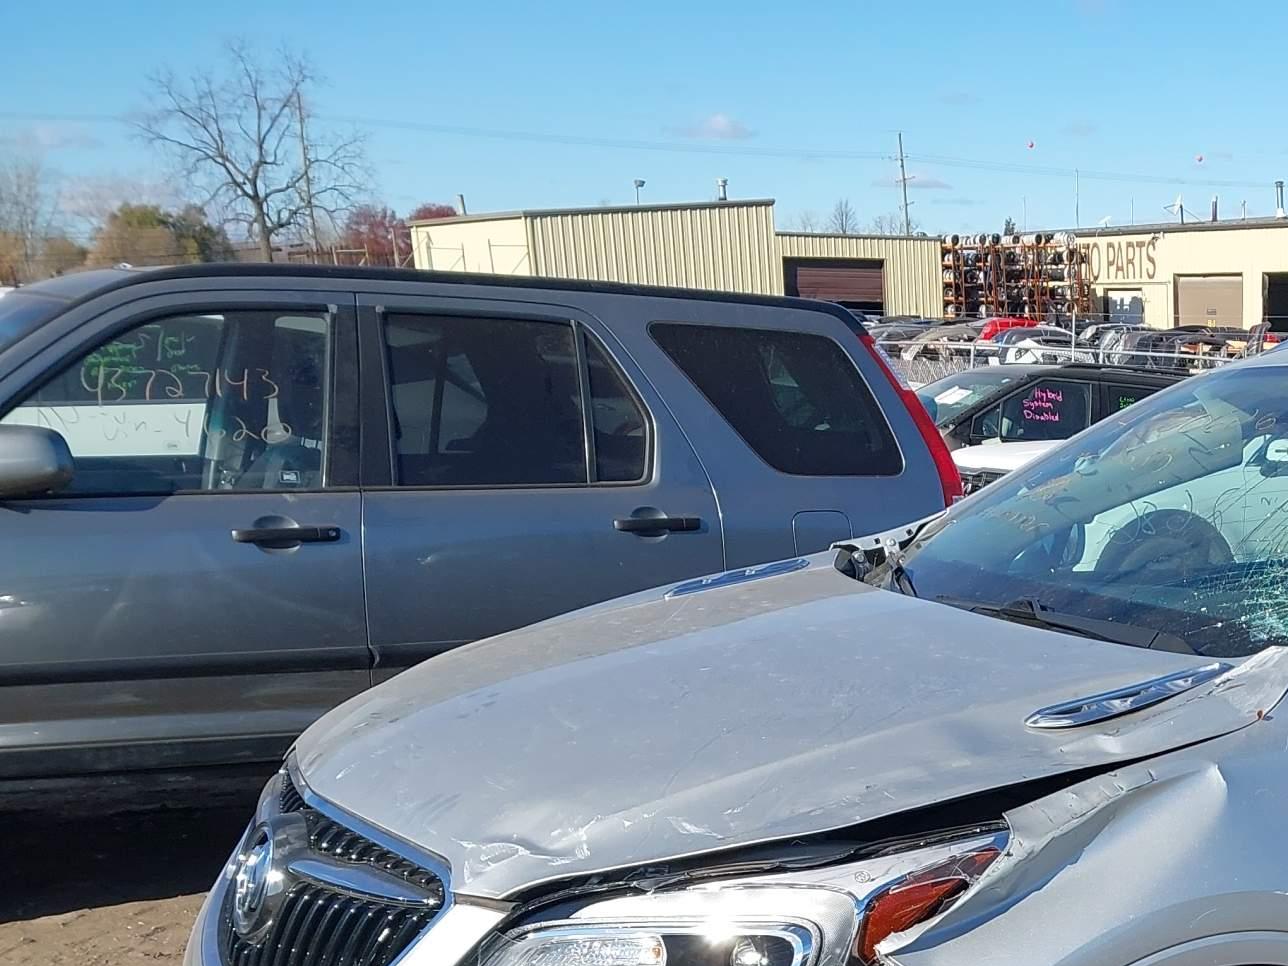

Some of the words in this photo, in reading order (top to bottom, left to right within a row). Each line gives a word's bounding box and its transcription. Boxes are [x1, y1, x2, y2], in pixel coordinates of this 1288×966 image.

[1106, 240, 1157, 280] PARTS
[80, 367, 280, 407] 43727143
[1034, 386, 1063, 402] Hybrid
[1023, 409, 1060, 422] Disabled
